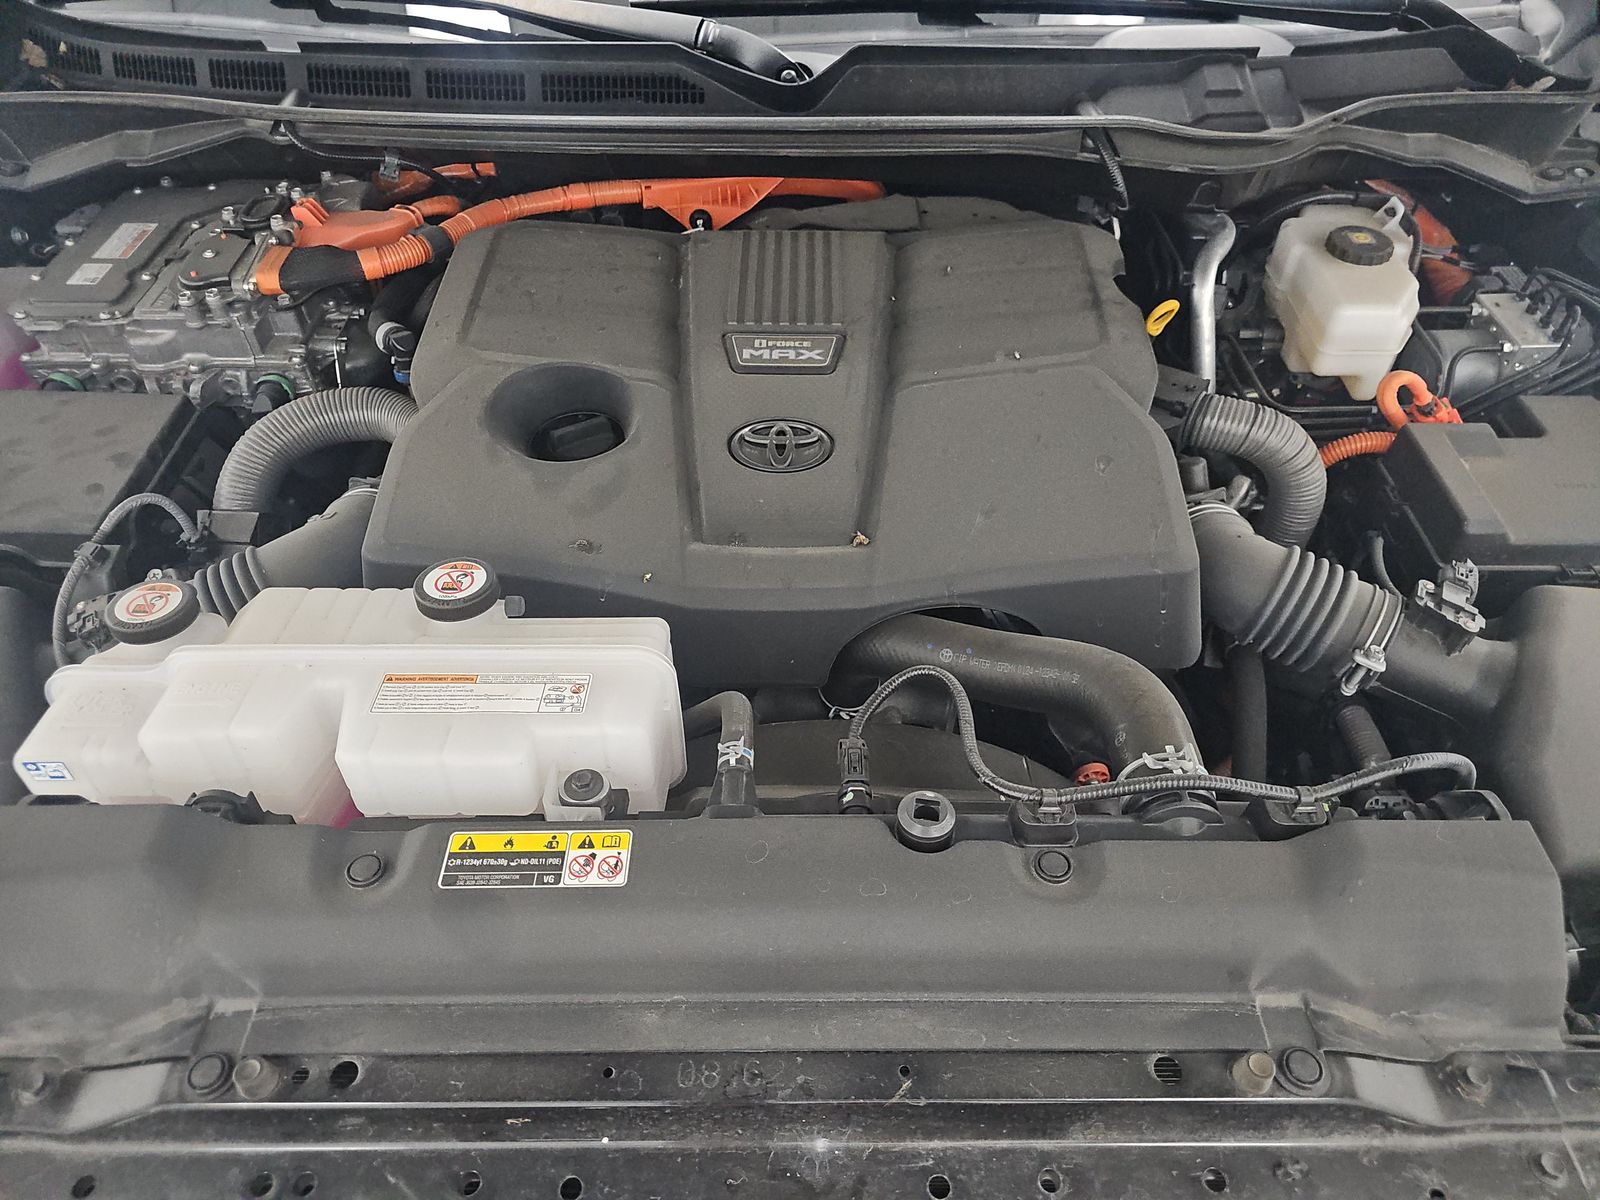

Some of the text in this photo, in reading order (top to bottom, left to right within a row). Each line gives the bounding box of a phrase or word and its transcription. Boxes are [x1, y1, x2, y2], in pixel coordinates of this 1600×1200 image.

[742, 348, 825, 360] MAX
[455, 858, 482, 867] R-1234yf
[546, 857, 562, 866] (POE)
[543, 875, 555, 883] VG
